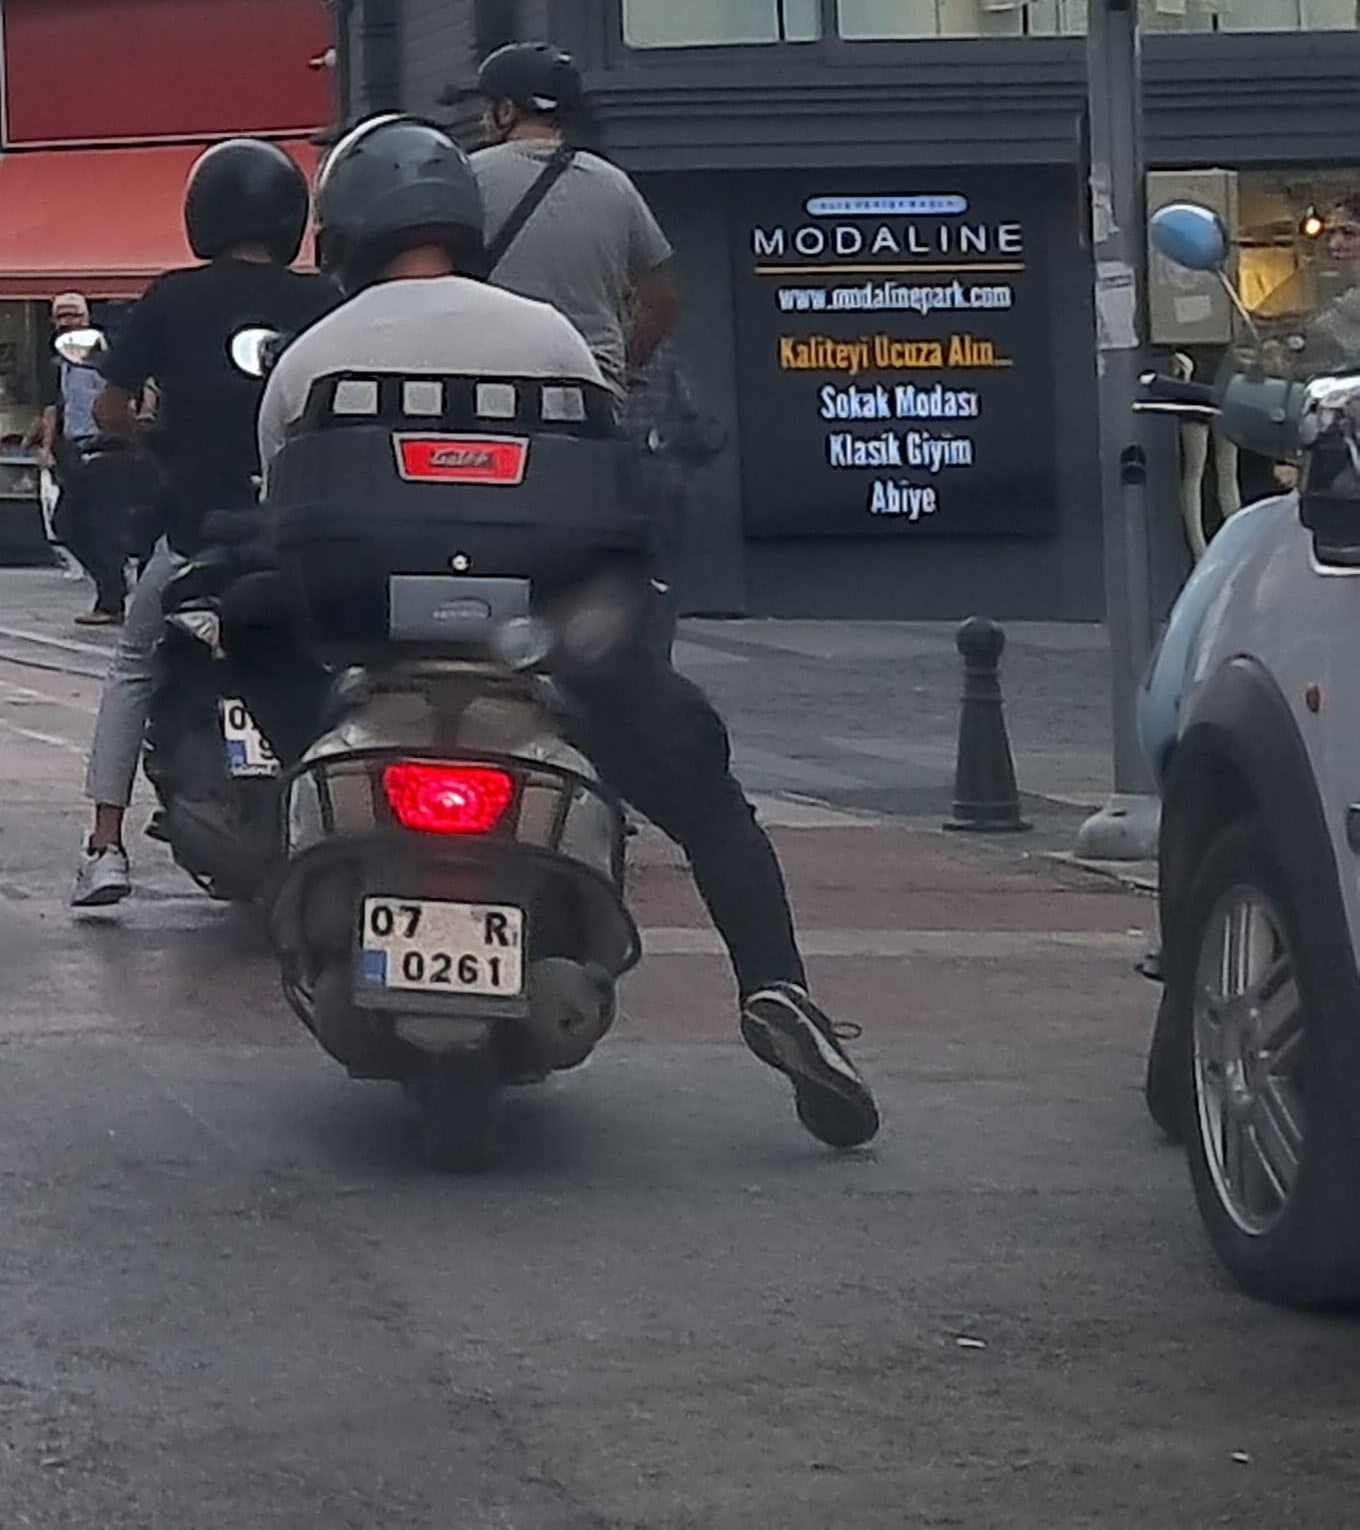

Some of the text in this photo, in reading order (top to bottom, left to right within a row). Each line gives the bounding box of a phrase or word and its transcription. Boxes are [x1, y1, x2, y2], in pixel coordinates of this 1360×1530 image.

[754, 224, 1024, 255] MODALINE
[778, 281, 1012, 315] www.modalinepark.com
[780, 335, 870, 376] Kaliteyi
[875, 335, 943, 367] Ucuza
[820, 383, 979, 419] Sokak Modası
[829, 431, 973, 472] Klasik Giyim
[870, 479, 936, 520] Abiye
[371, 905, 422, 938] 07
[402, 951, 500, 987] 0261
